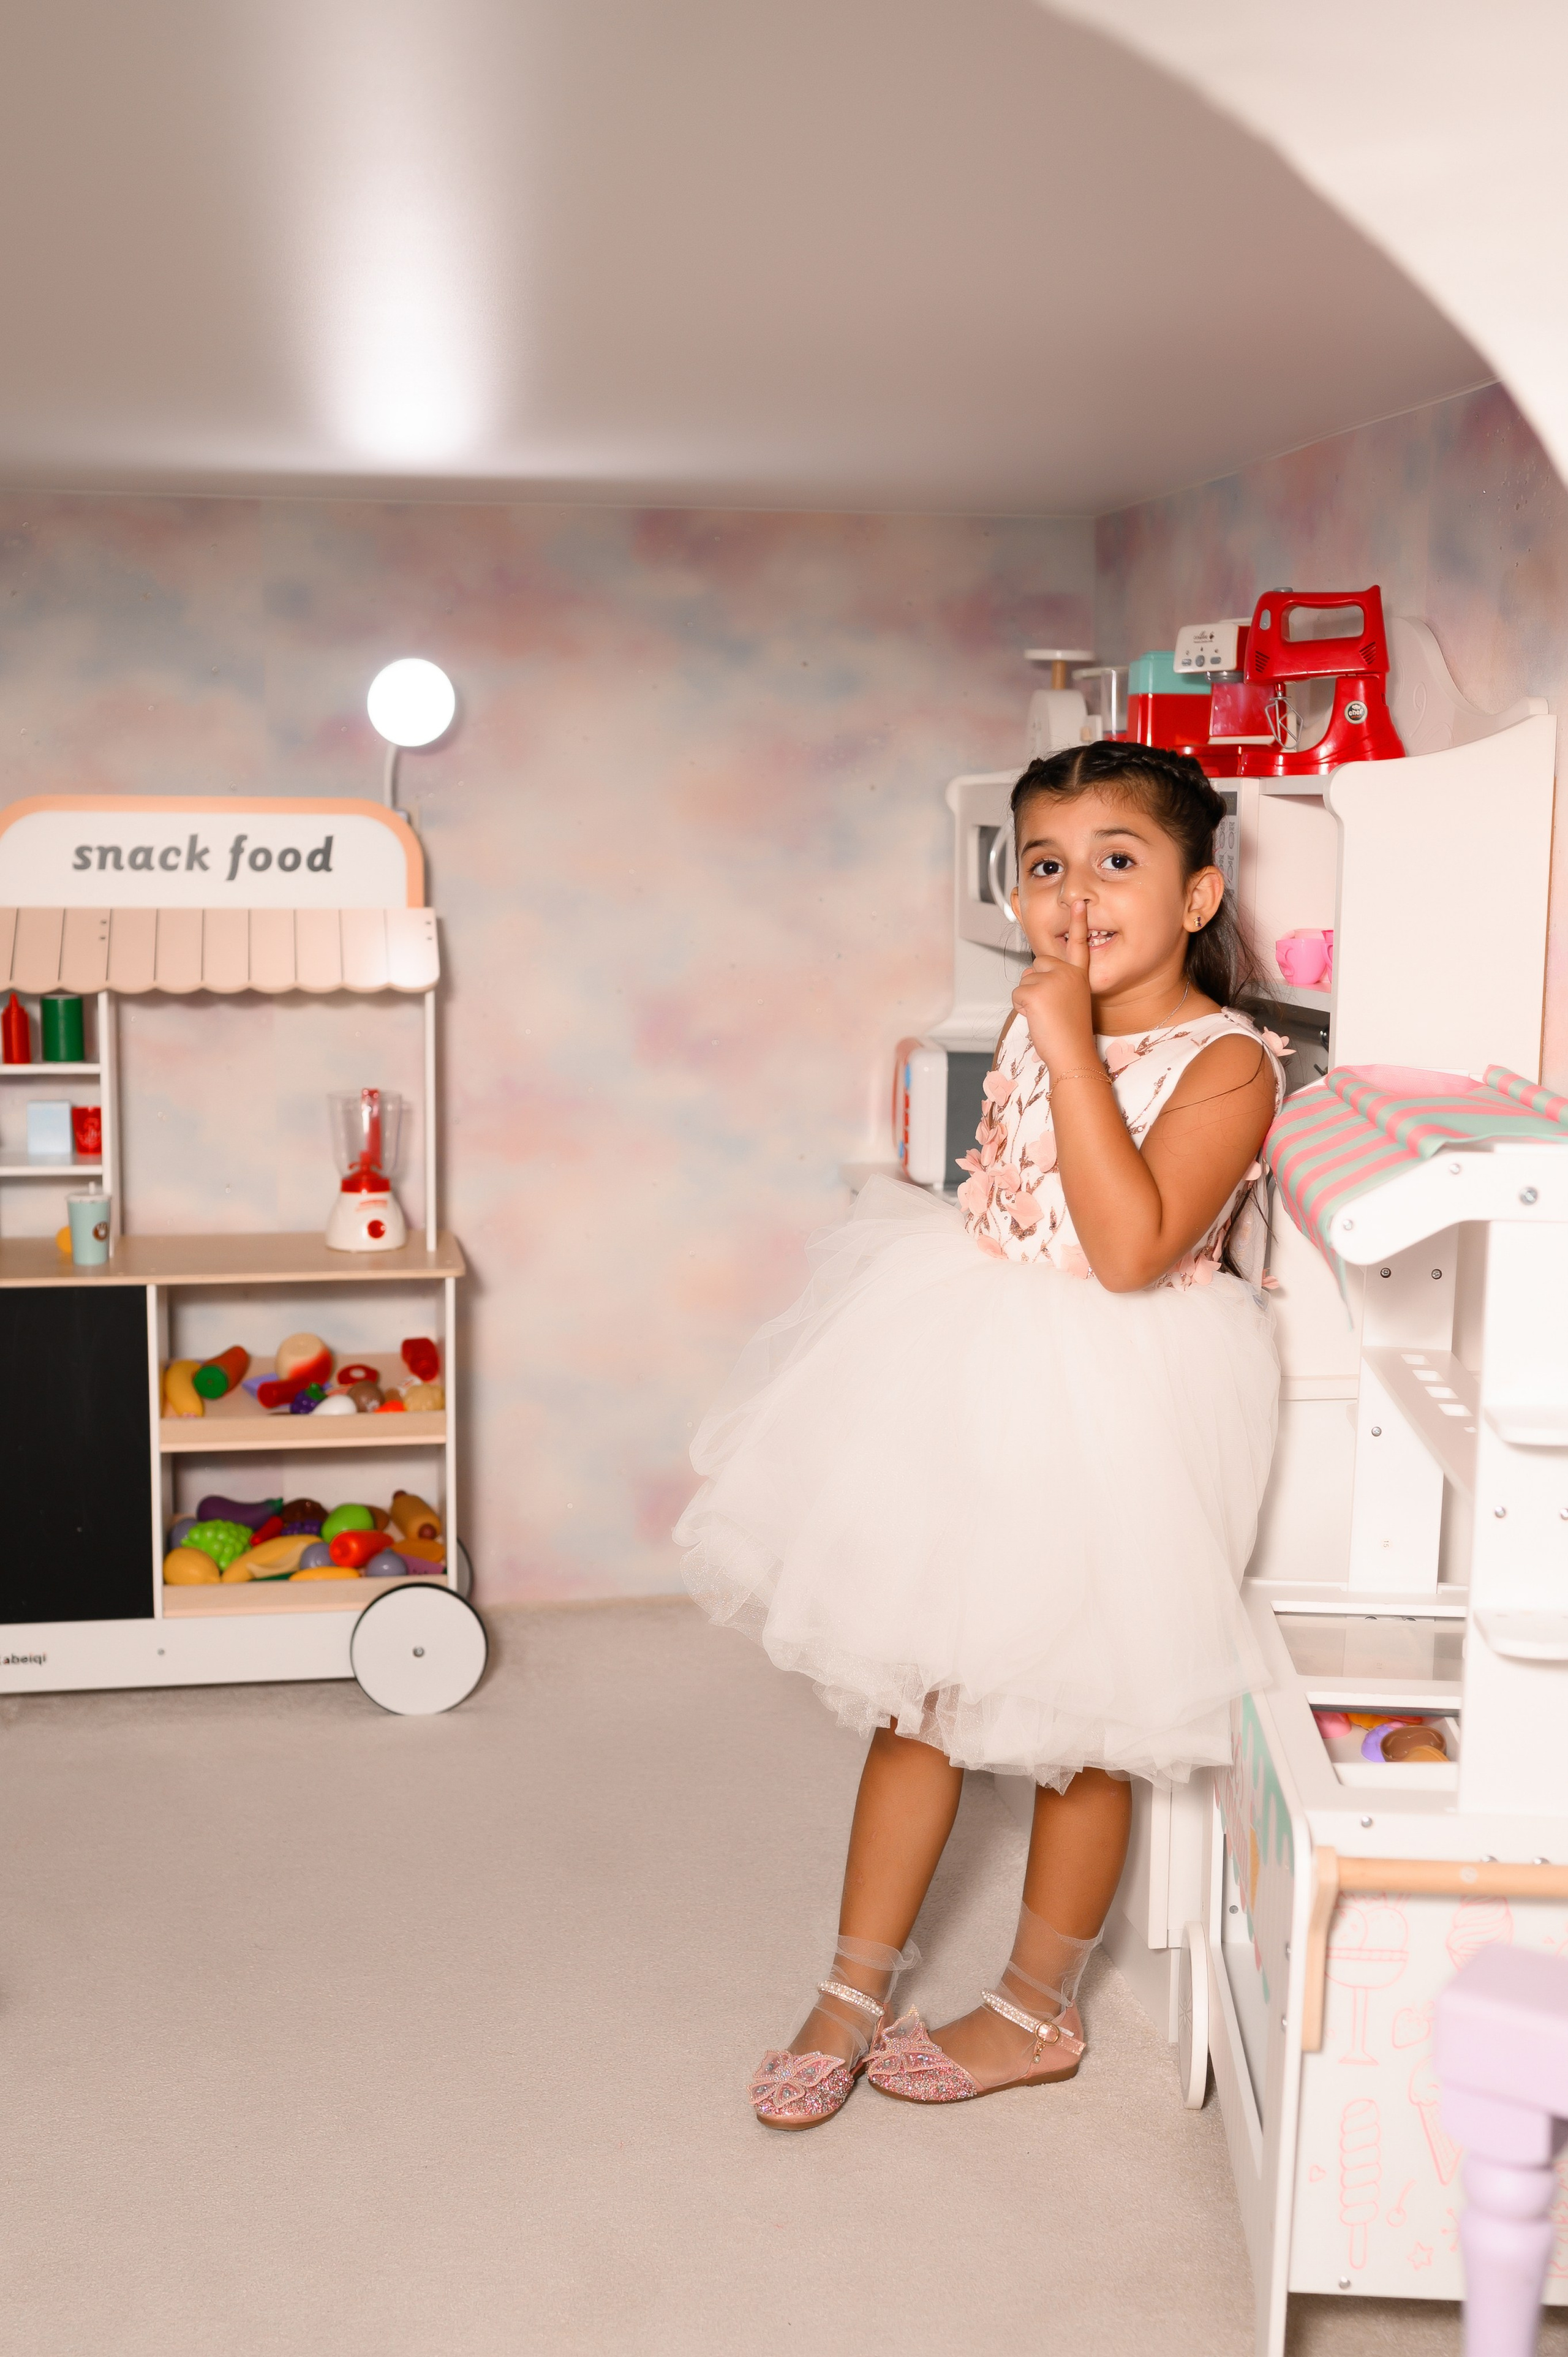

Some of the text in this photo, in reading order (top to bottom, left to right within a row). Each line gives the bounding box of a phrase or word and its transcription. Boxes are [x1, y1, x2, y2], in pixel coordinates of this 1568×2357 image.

[72, 834, 334, 881] snack food
[0, 1652, 47, 1666] abeiqi
